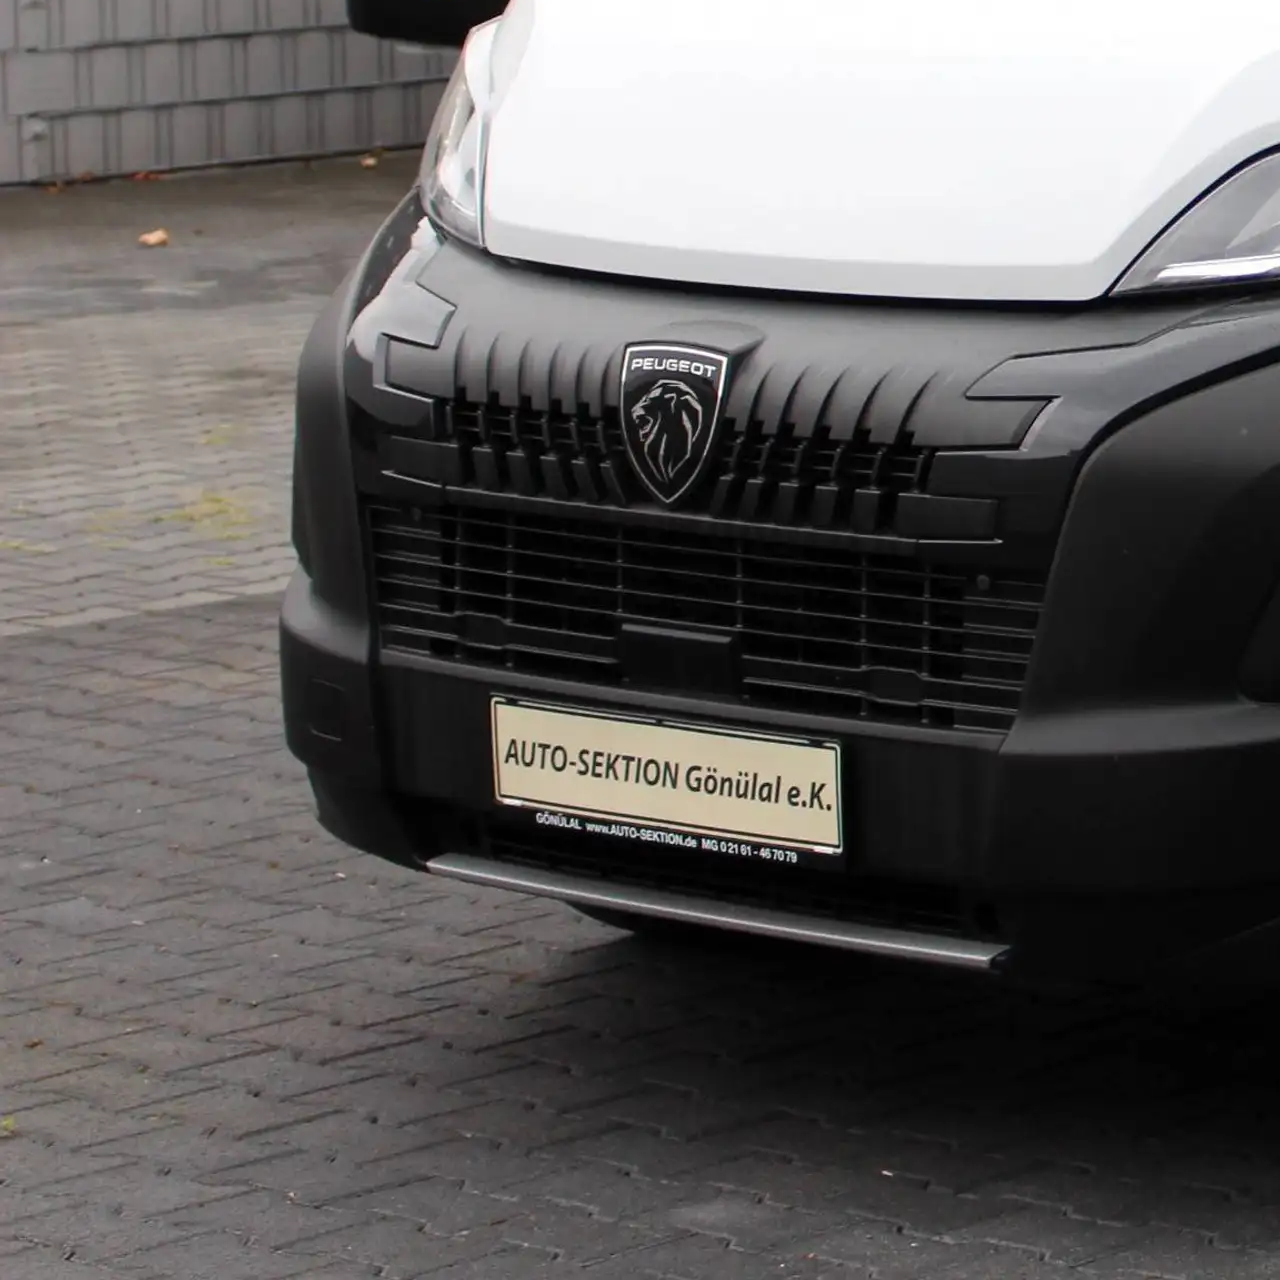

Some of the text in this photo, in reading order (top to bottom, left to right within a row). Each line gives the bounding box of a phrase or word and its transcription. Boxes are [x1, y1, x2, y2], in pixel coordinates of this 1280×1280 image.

[631, 357, 717, 378] PEUGEOT
[504, 738, 832, 811] AUTO-SEKTION Gönülal e.K.
[535, 811, 583, 830] GÖNÜLAL
[585, 822, 698, 848] www.AUTO-SEKTION.de
[701, 837, 719, 852] MG
